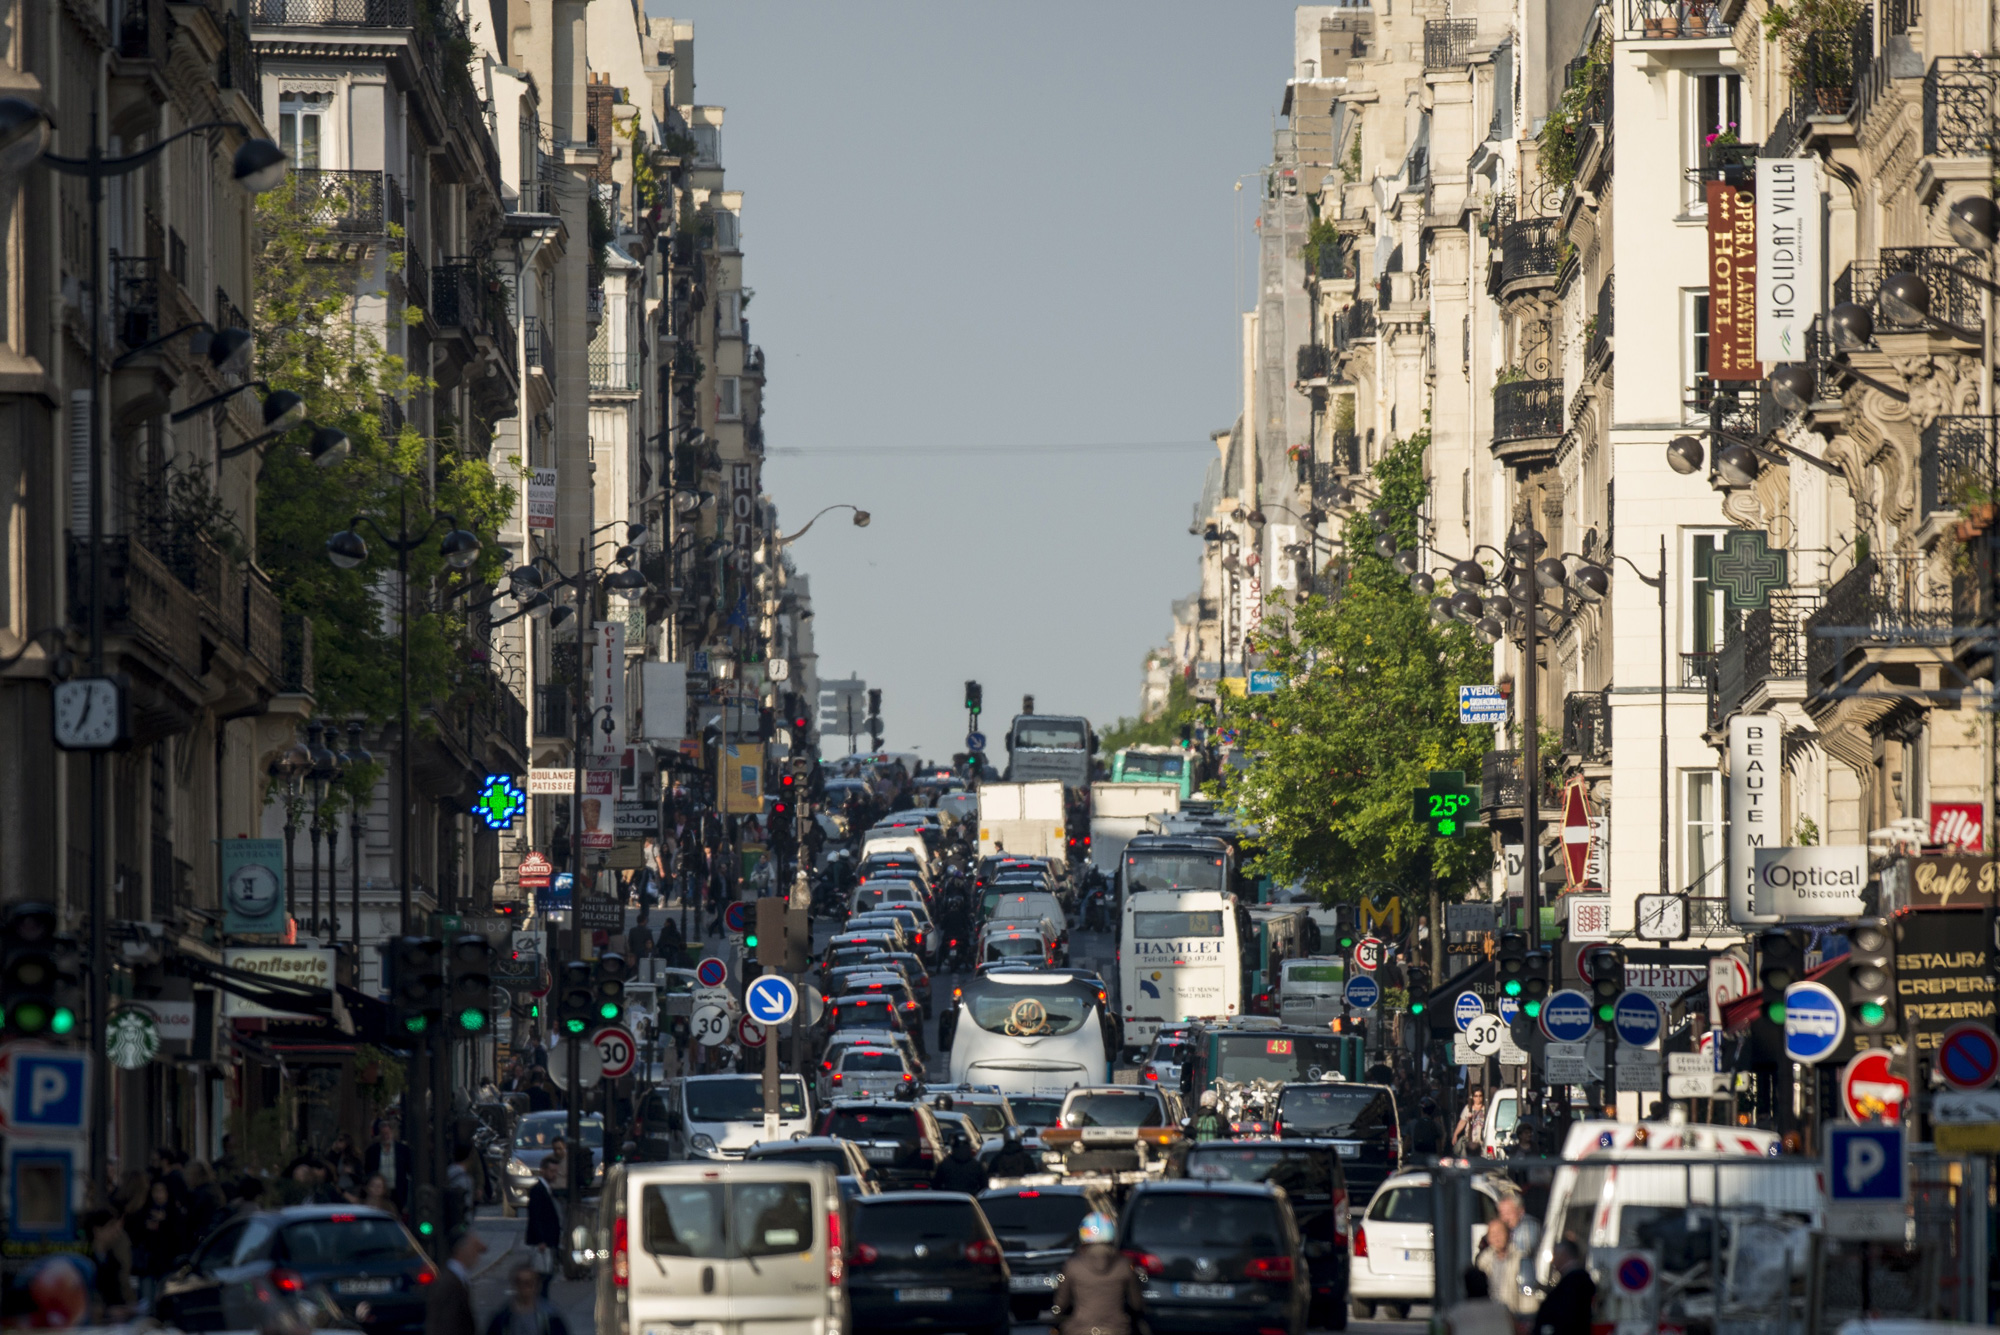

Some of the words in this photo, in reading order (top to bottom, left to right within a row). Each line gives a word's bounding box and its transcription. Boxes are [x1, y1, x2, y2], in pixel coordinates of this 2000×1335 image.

[1772, 164, 1795, 215] VILLA
[1772, 224, 1795, 318] HOLIDAY
[1714, 230, 1733, 333] HOTEL
[1736, 264, 1756, 370] LAFAYETTE
[533, 472, 556, 486] LOUER
[1462, 688, 1469, 696] A
[531, 771, 575, 780] BOULANGE
[1747, 727, 1764, 823] BEAUTE
[532, 782, 574, 790] PATISSIE
[1933, 809, 1982, 845] illy
[1769, 864, 1860, 890] Optical
[1798, 888, 1857, 899] Discount
[580, 903, 620, 913] JOUTIER
[1360, 895, 1401, 935] M
[1134, 941, 1225, 955] HAMLET
[233, 957, 328, 973] Confiserie
[1018, 1003, 1039, 1021] 40
[1904, 1000, 1997, 1020] PIZZERIA
[699, 1018, 722, 1034] 30
[1474, 1027, 1497, 1043] 30
[600, 1043, 626, 1063] 30
[1271, 1040, 1287, 1053] 43
[30, 1064, 68, 1117] P
[1845, 1136, 1886, 1193] P
